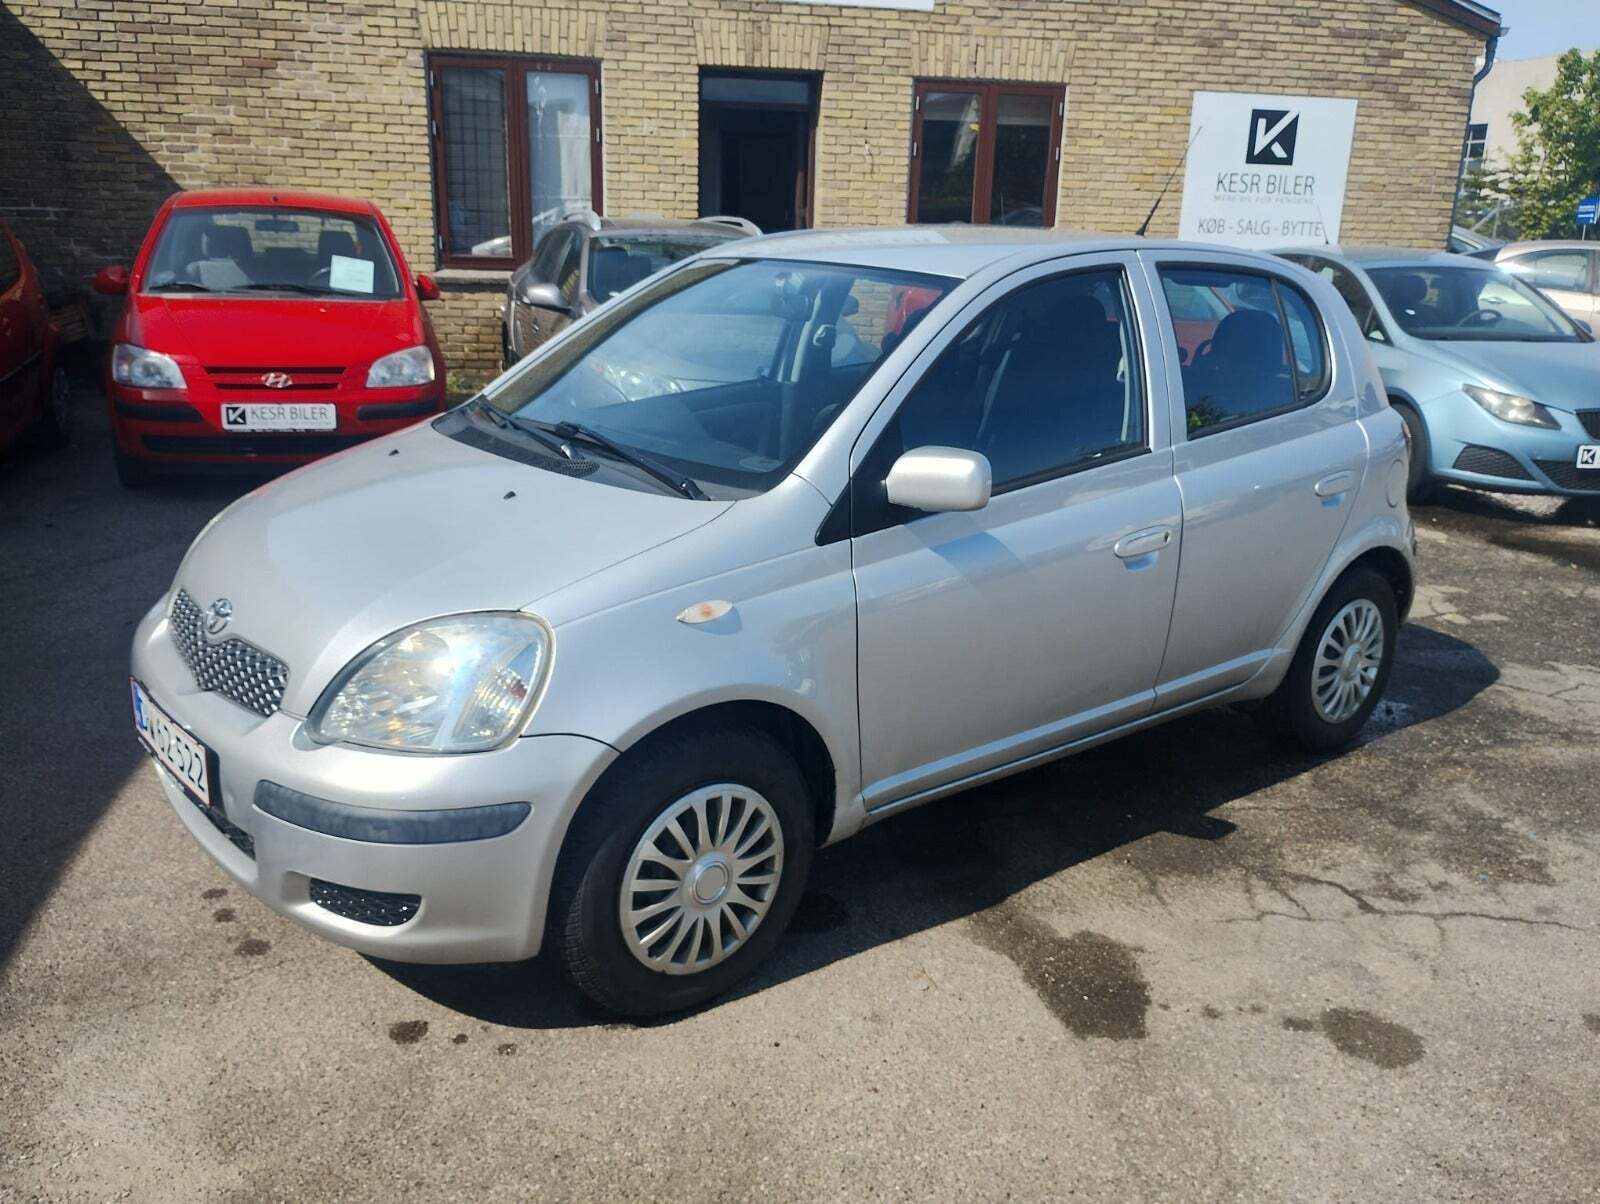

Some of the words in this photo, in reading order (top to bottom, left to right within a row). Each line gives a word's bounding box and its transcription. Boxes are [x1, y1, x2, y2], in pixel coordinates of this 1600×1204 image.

[1216, 172, 1261, 194] KESR
[1265, 174, 1315, 196] BILER
[1197, 218, 1226, 234] KØB
[1236, 219, 1271, 235] SALG
[1281, 220, 1322, 237] BYTTE
[250, 407, 286, 420] KESR
[289, 407, 328, 420] BILER
